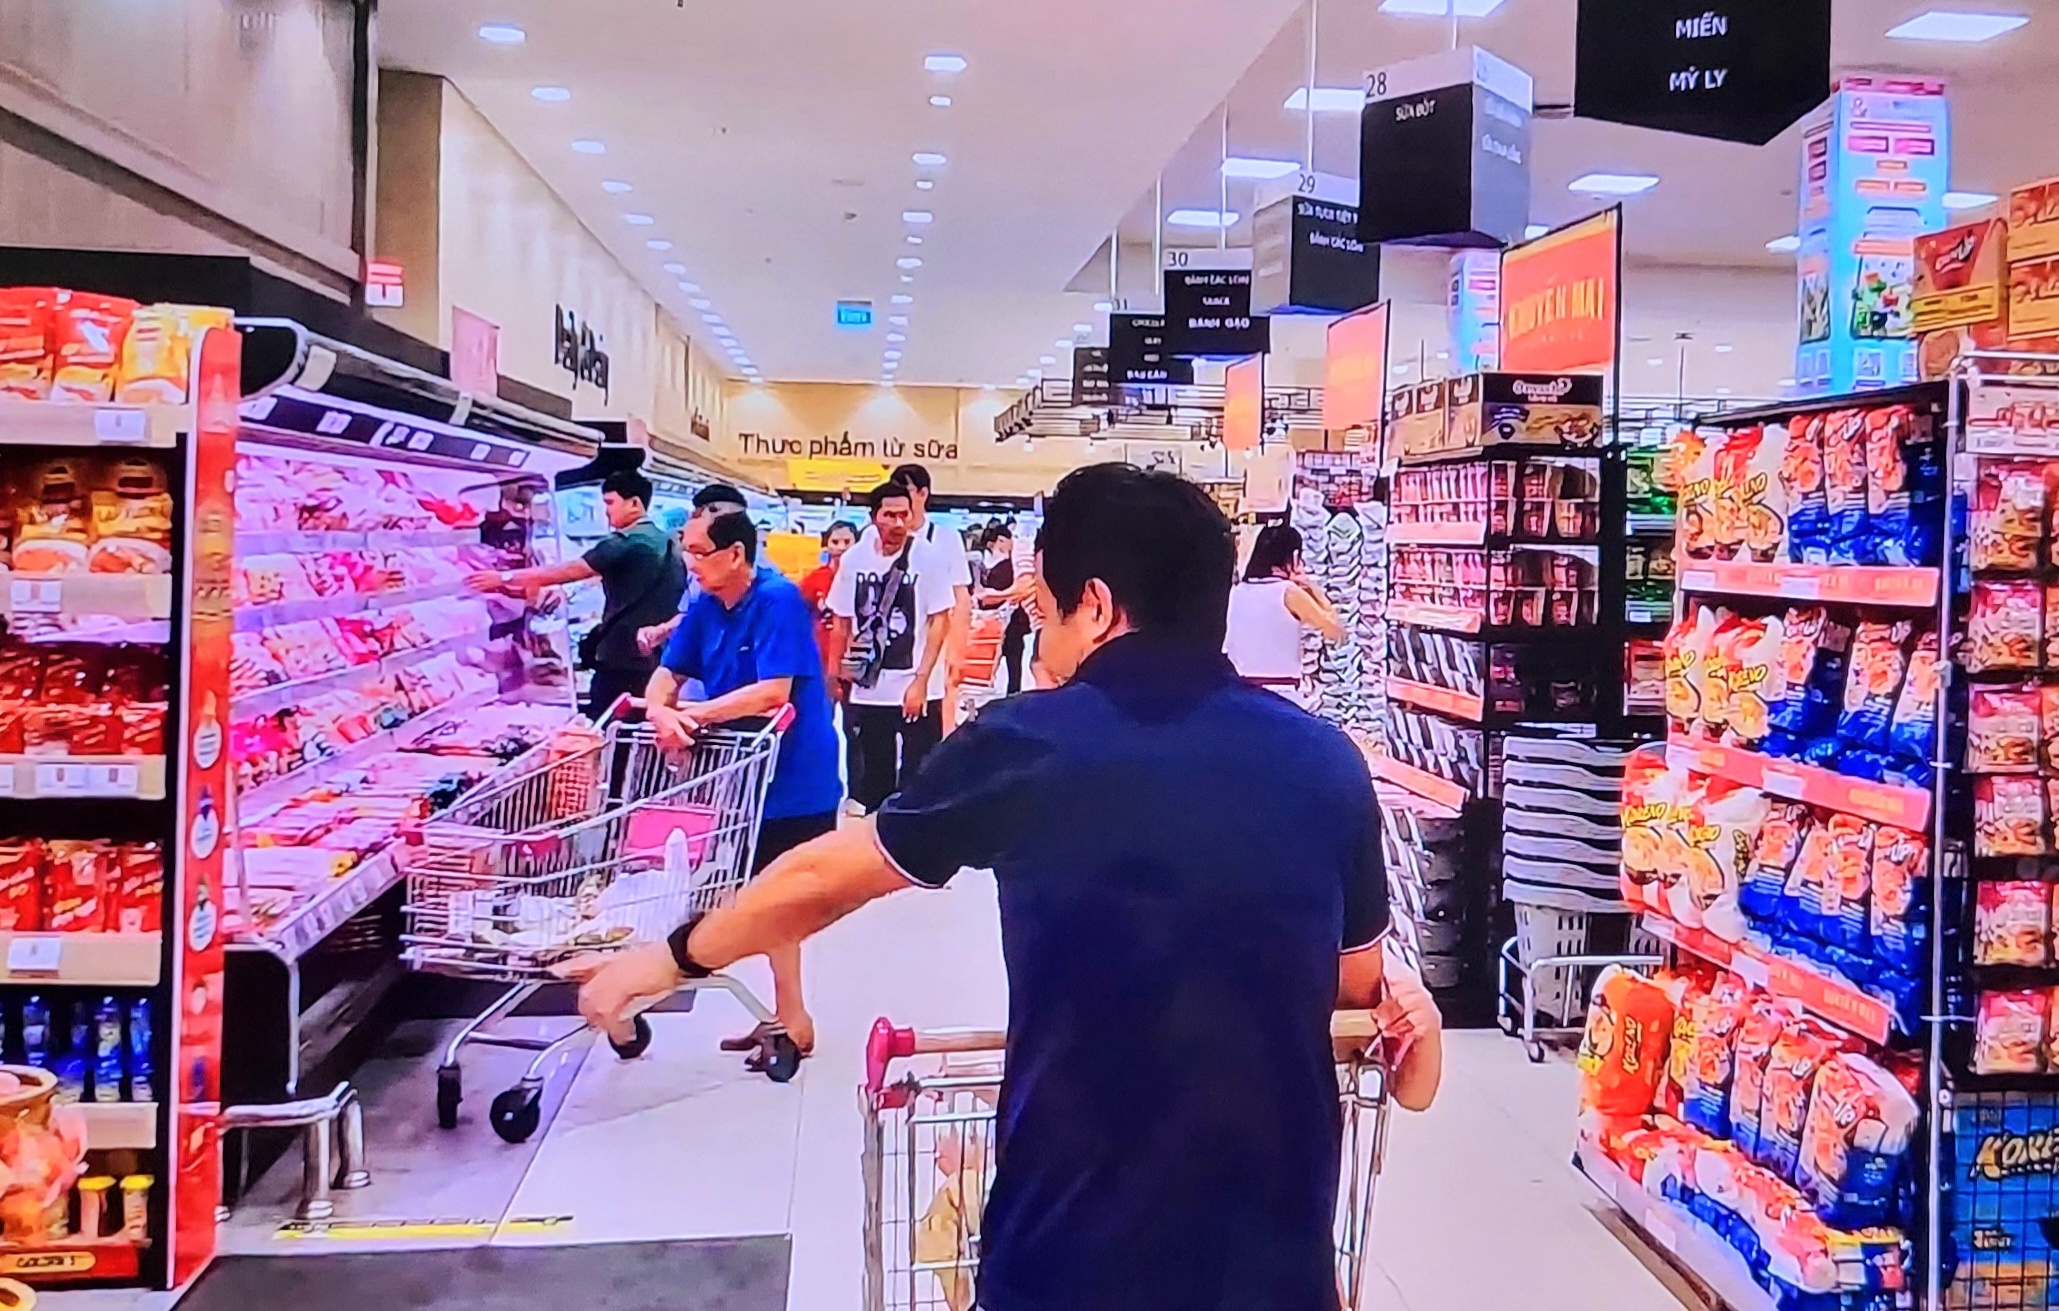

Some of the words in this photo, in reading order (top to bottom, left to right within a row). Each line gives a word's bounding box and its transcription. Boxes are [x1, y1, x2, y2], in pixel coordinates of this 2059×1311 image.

[1675, 11, 1728, 39] MIẾN
[1366, 72, 1387, 98] 28
[1704, 68, 1728, 90] LY
[1298, 173, 1316, 194] 29
[1167, 251, 1188, 268] 30
[809, 430, 875, 460] phẩm
[883, 436, 906, 458] từ
[913, 438, 958, 460] sữa
